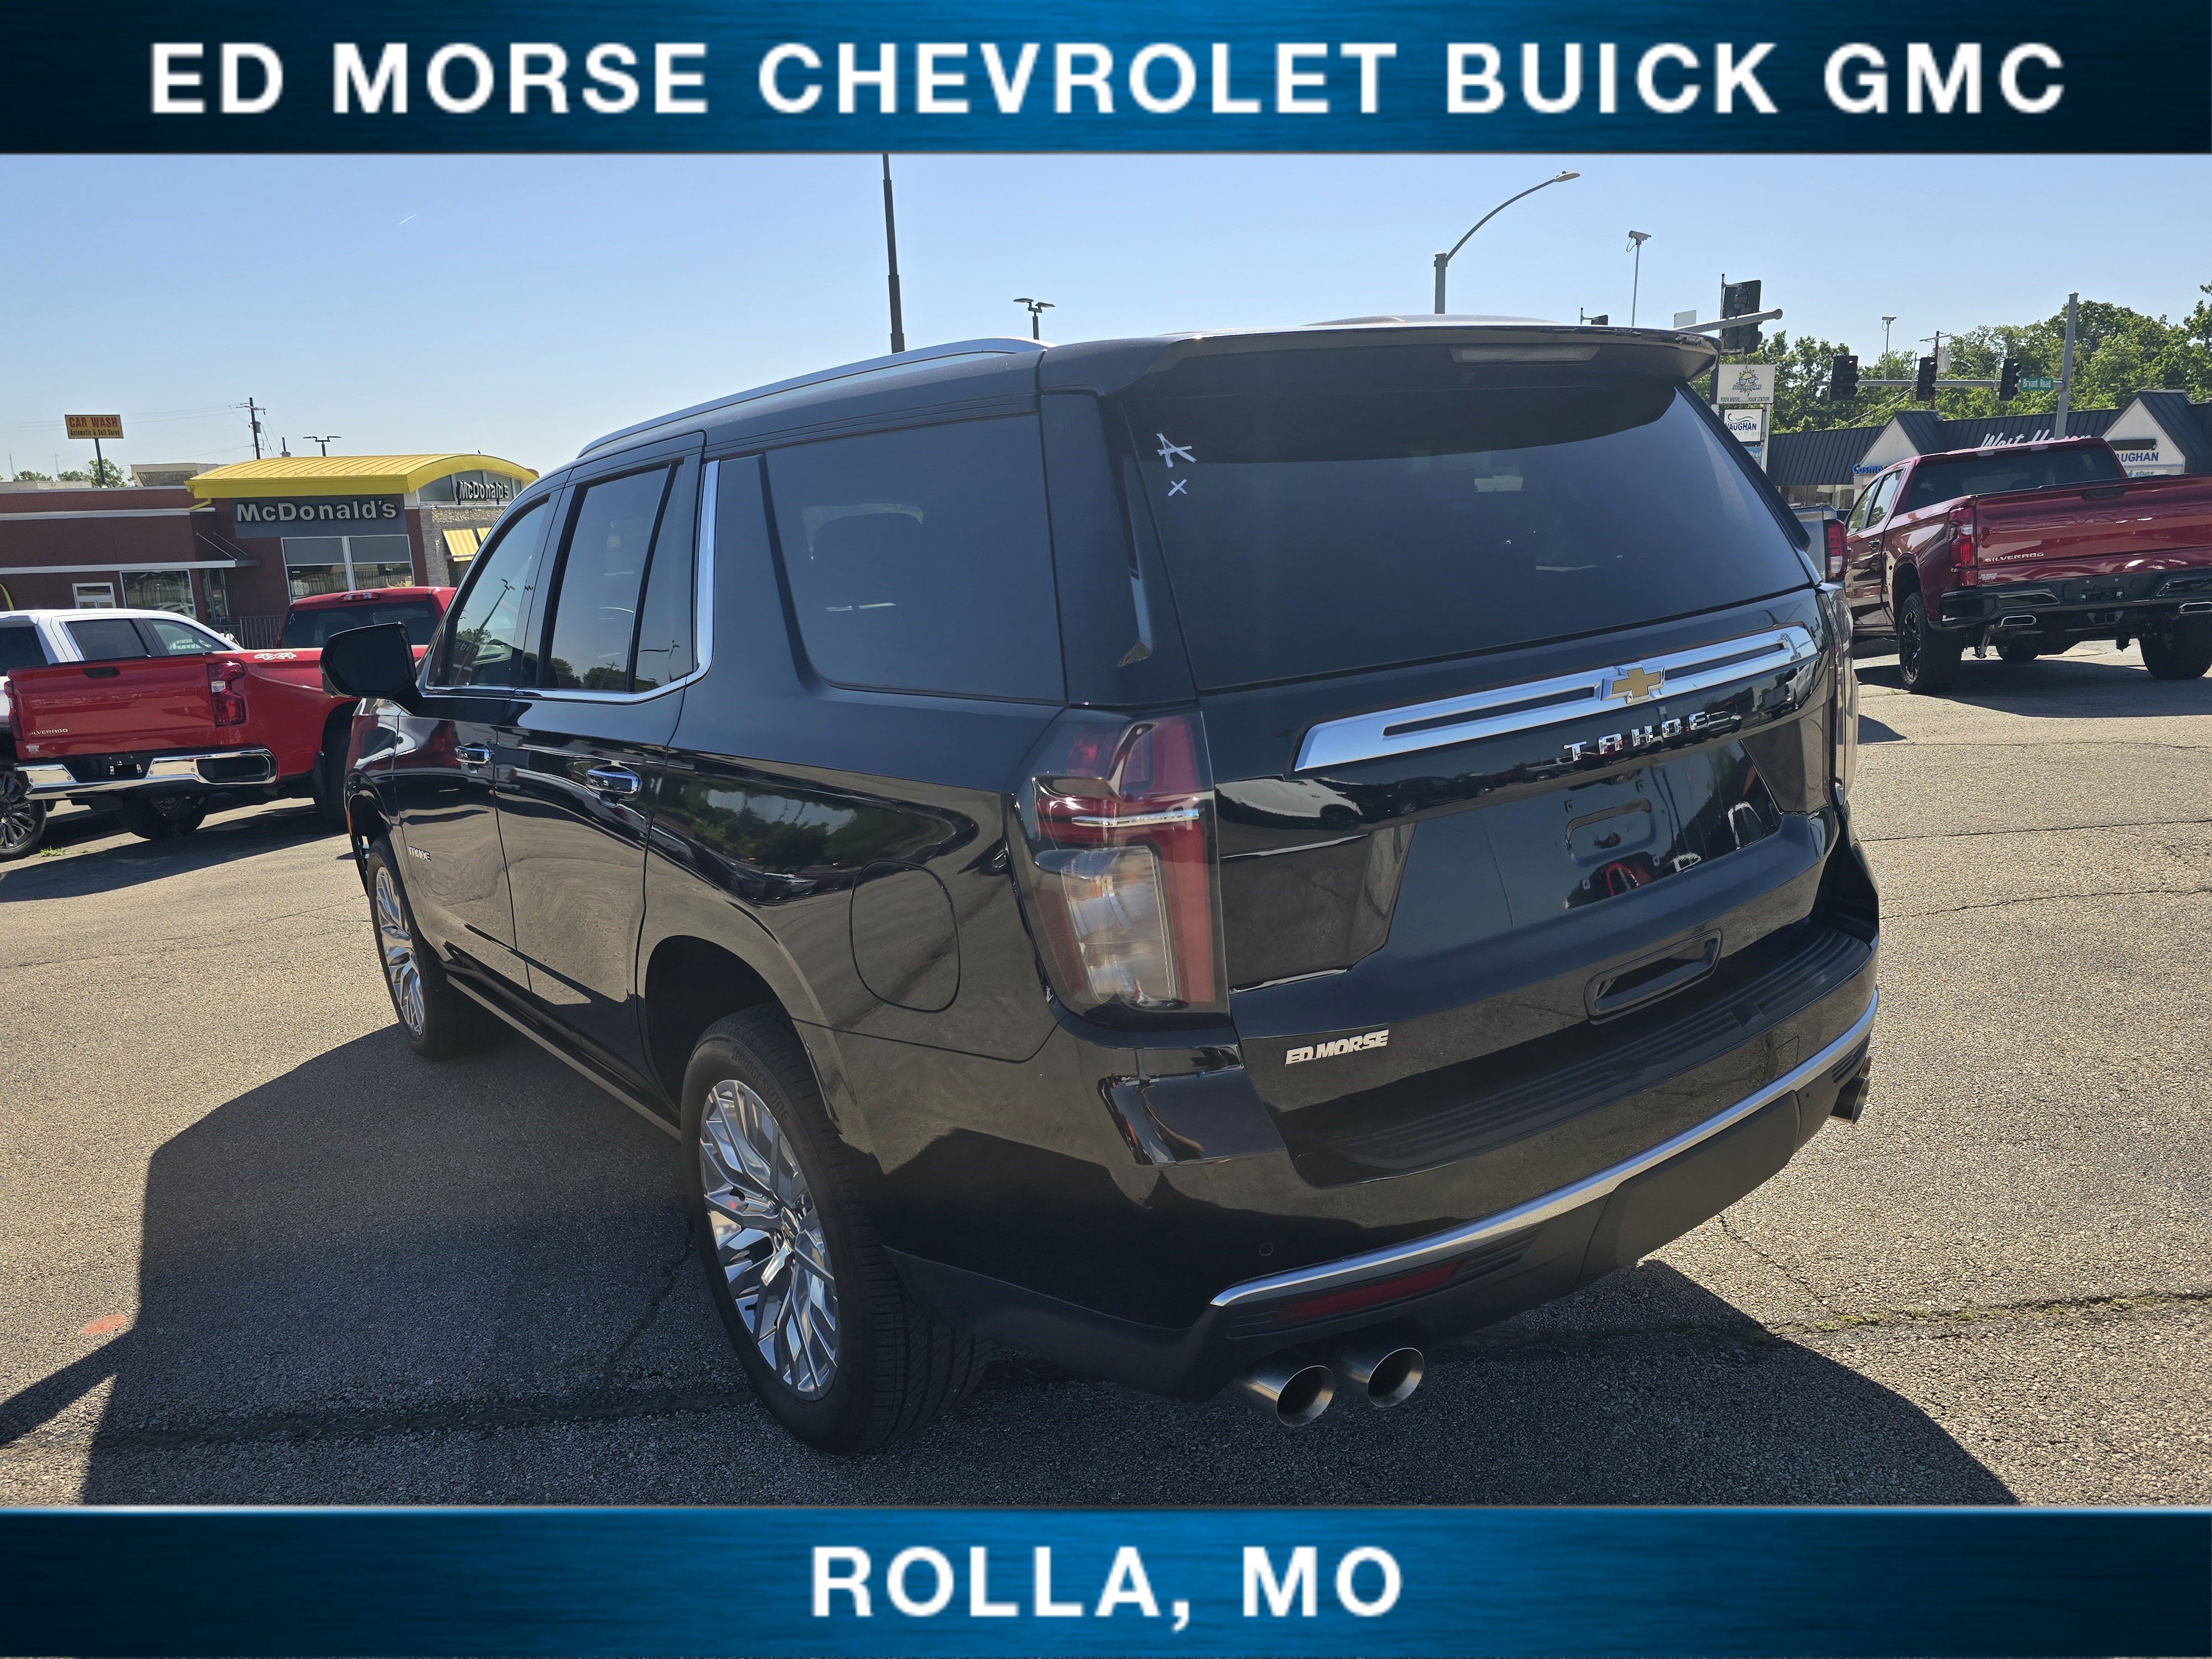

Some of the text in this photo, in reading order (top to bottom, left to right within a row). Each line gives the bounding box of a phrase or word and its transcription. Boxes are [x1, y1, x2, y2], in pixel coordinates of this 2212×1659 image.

[2023, 378, 2051, 389] Bryant Road
[69, 416, 117, 428] CAR WASH
[1725, 422, 1757, 431] VAUGHAN
[2116, 451, 2159, 462] UGHAN
[1852, 463, 1883, 474] Cosmo
[236, 499, 397, 522] McDonald's
[1984, 552, 2045, 563] SILVERADO
[27, 728, 69, 737] SILVERADO
[1563, 711, 1709, 762] TAHOE
[1285, 1029, 1389, 1067] ED MORSE
[731, 1046, 791, 1121] BRIDGESTONE
